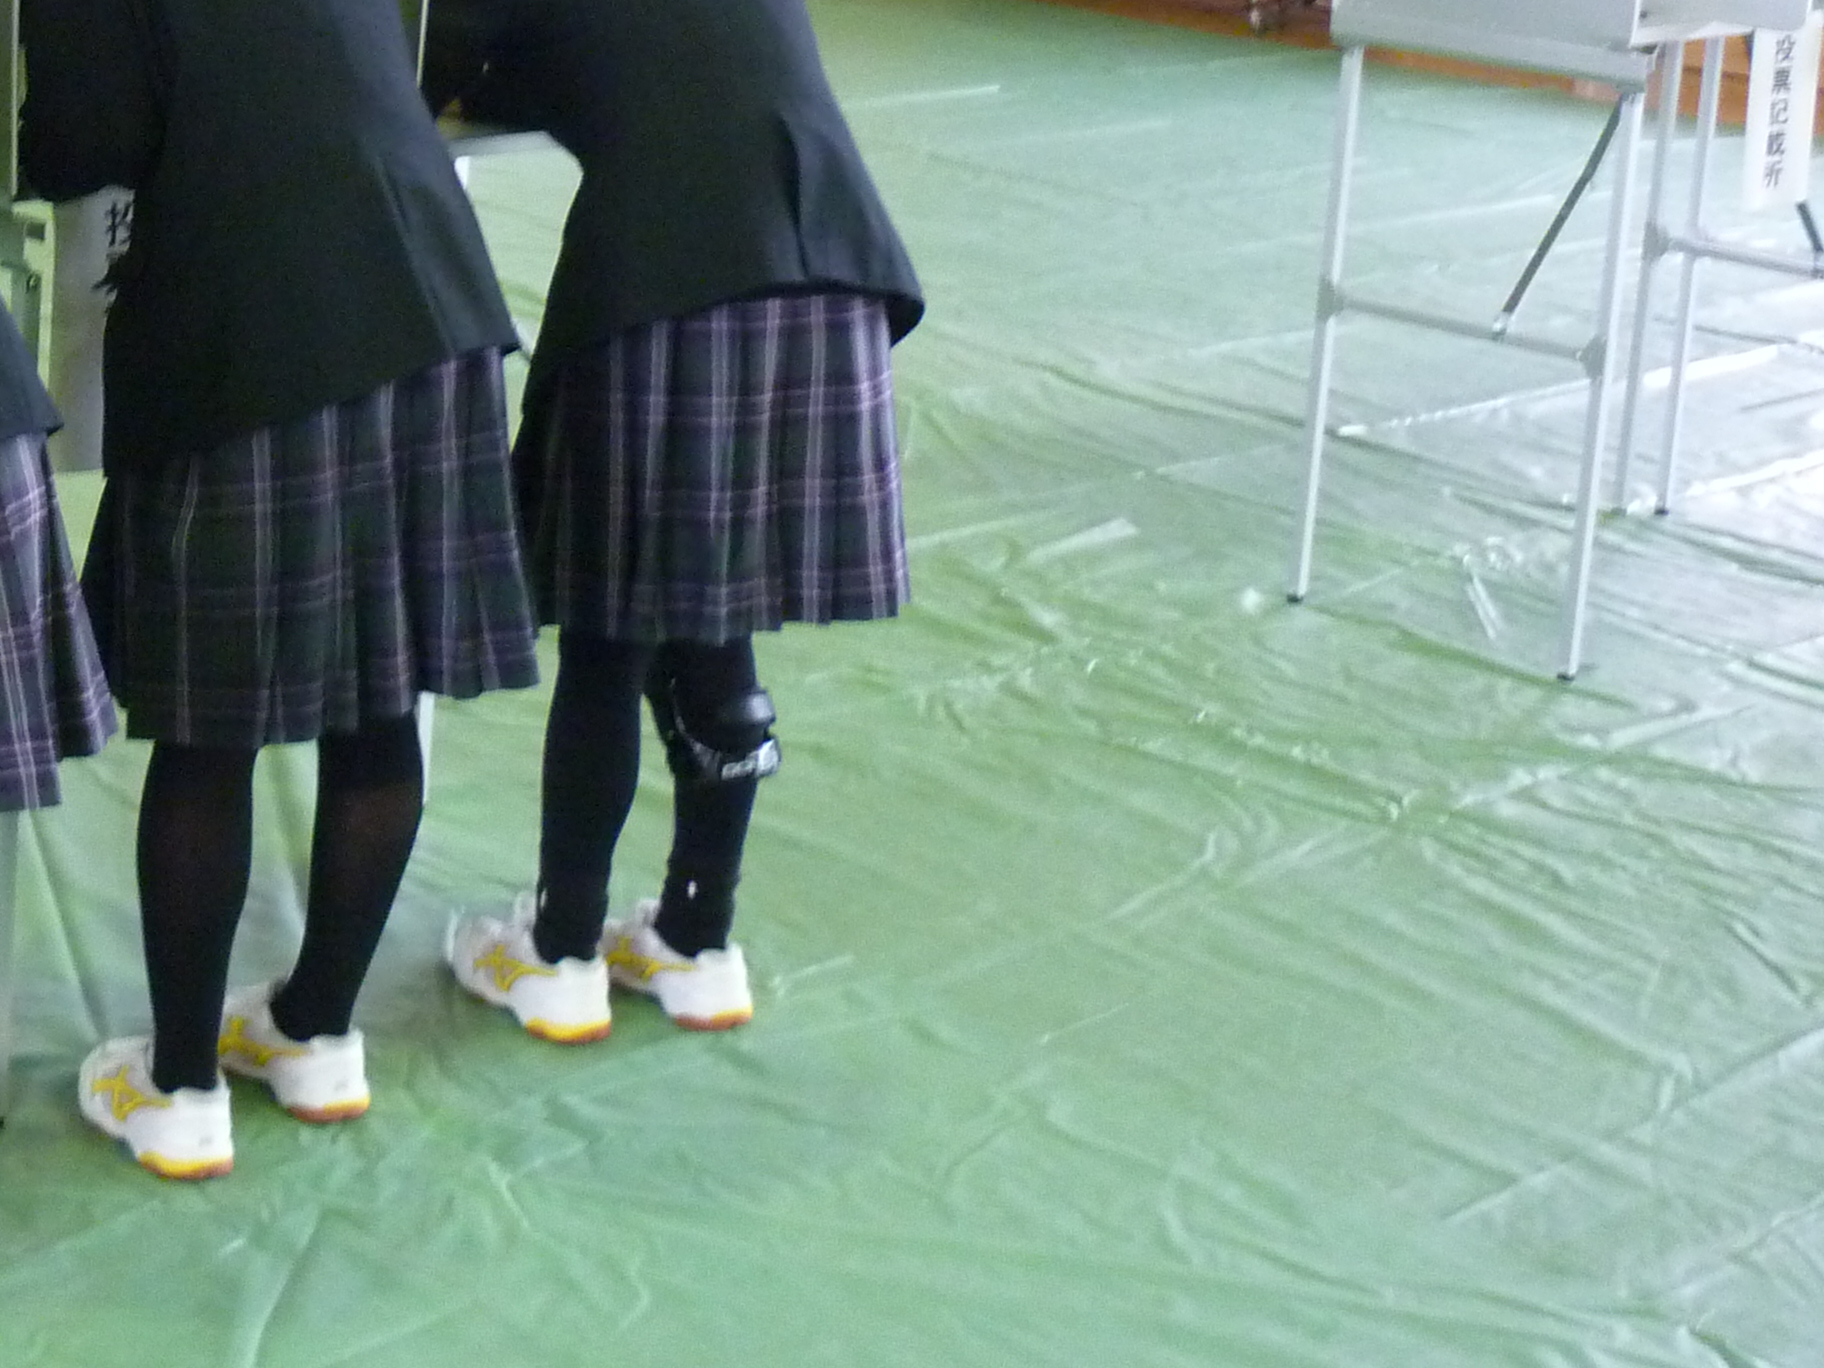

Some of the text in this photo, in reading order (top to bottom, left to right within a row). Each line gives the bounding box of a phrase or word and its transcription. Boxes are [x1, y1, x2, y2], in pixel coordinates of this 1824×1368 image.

[1765, 35, 1795, 186] 投票記載所
